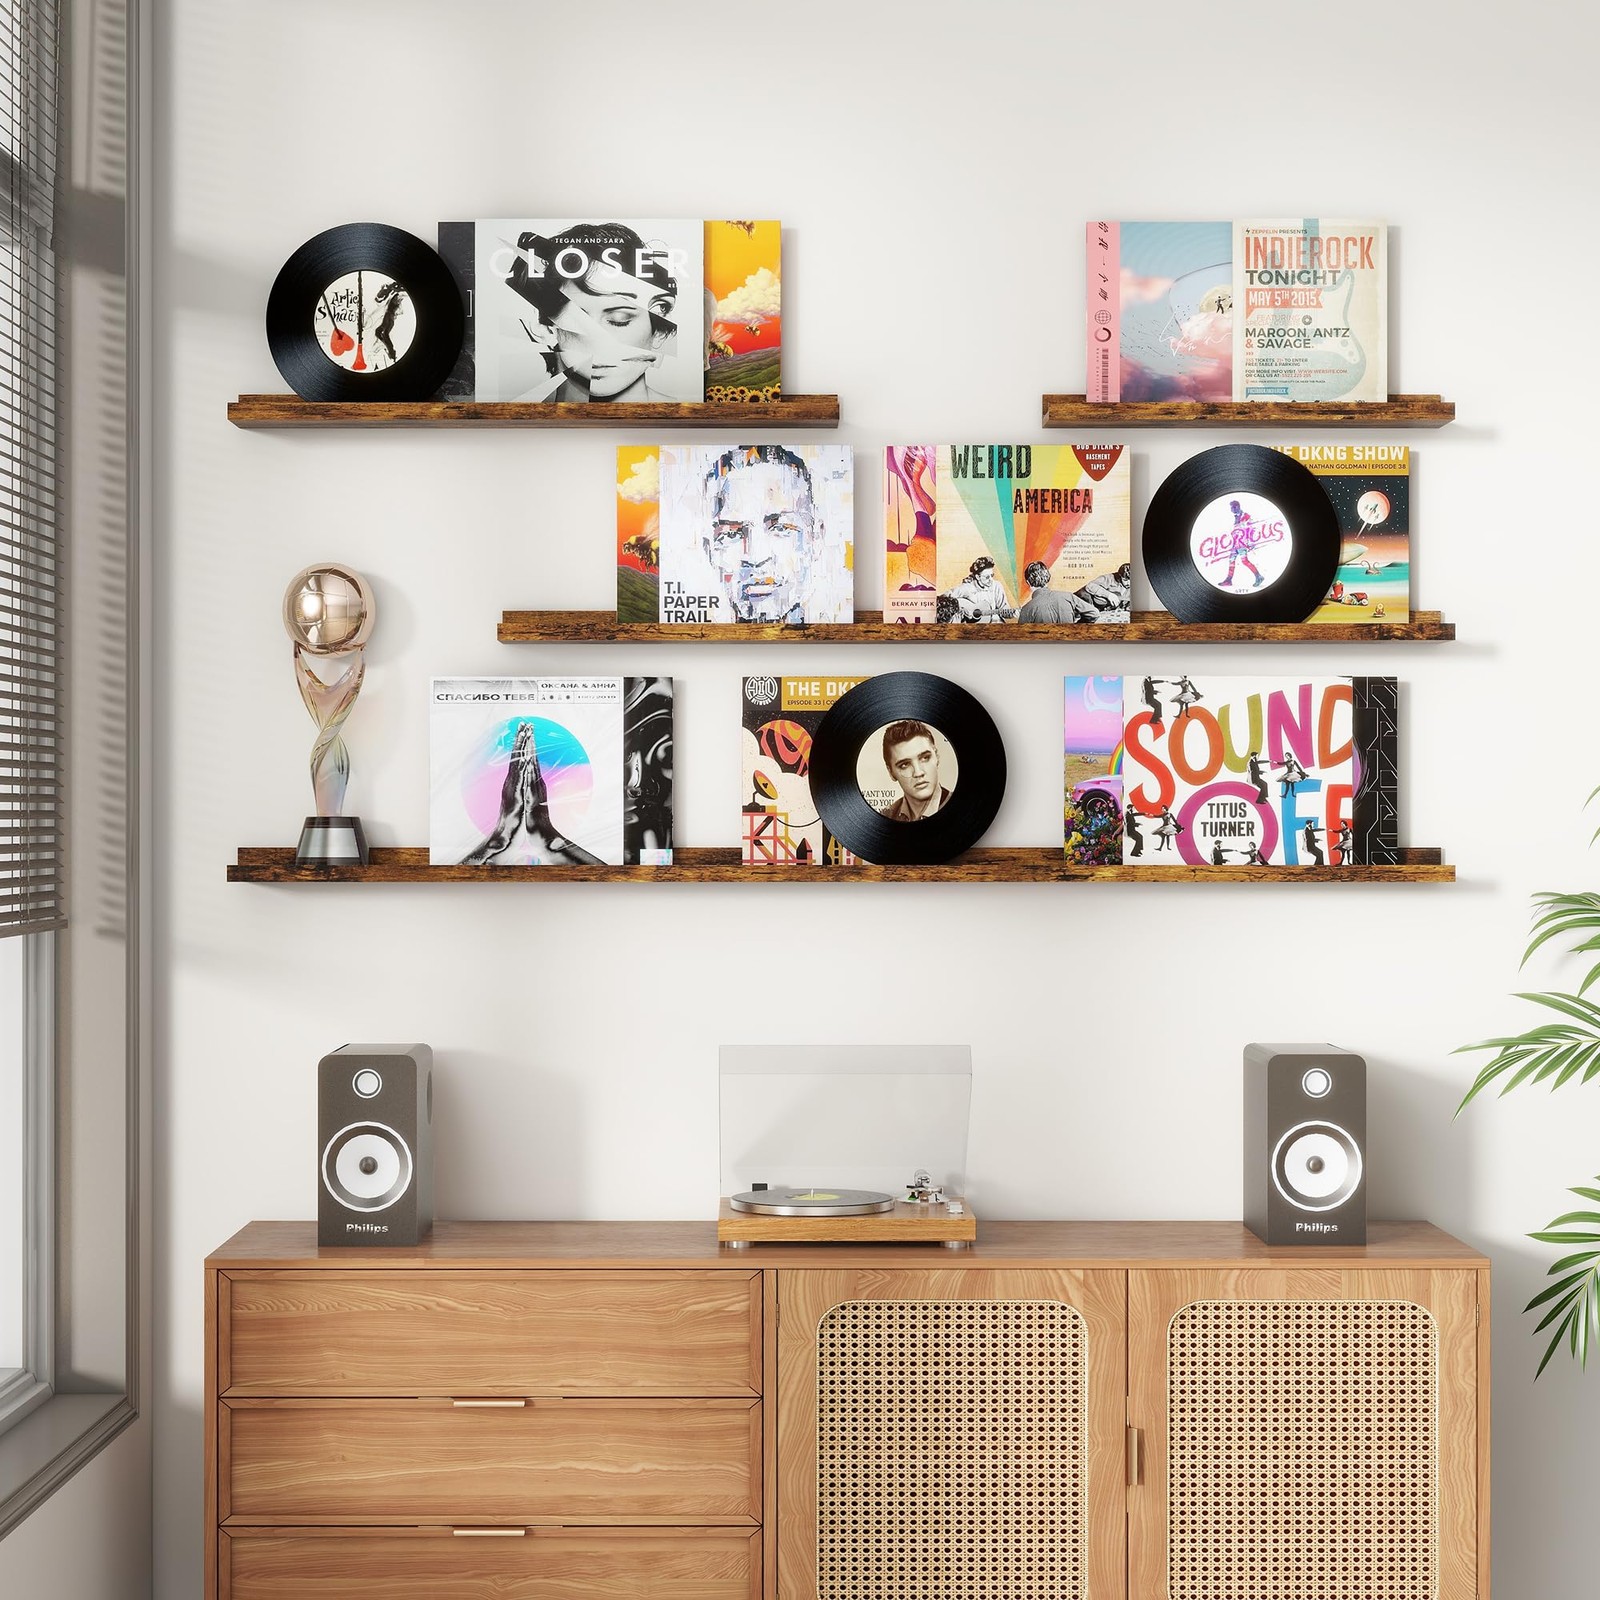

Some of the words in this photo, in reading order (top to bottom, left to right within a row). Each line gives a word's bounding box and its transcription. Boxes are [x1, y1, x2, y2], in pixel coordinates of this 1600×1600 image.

[1245, 236, 1375, 269] INDIEROCK
[488, 247, 690, 279] CLOSER
[1245, 270, 1341, 285] TONIGHT
[1249, 290, 1271, 306] MAY
[1274, 290, 1290, 306] 5TH
[1291, 290, 1317, 306] 2015
[1313, 328, 1350, 338] ANTZ
[1245, 339, 1254, 348] &
[1257, 338, 1314, 348] SAVAGE.
[1299, 446, 1346, 461] DKNG
[1353, 446, 1405, 461] SHOW
[950, 445, 1031, 479] WEIRD
[1013, 488, 1093, 513] AMERICA
[1199, 521, 1285, 558] GLORIOUS
[664, 581, 686, 594] T.I.
[664, 596, 720, 609] PAPER
[664, 610, 712, 623] TRAIL
[786, 681, 820, 697] THE
[436, 693, 501, 701] СПАСИБО
[503, 693, 535, 701] ТЕБЕ
[1124, 683, 1353, 819] SOUND
[880, 790, 896, 798] YOU
[1207, 802, 1247, 818] TITUS
[1200, 821, 1255, 837] TURNER
[346, 1224, 389, 1234] Philips
[1295, 1223, 1339, 1234] Philips
